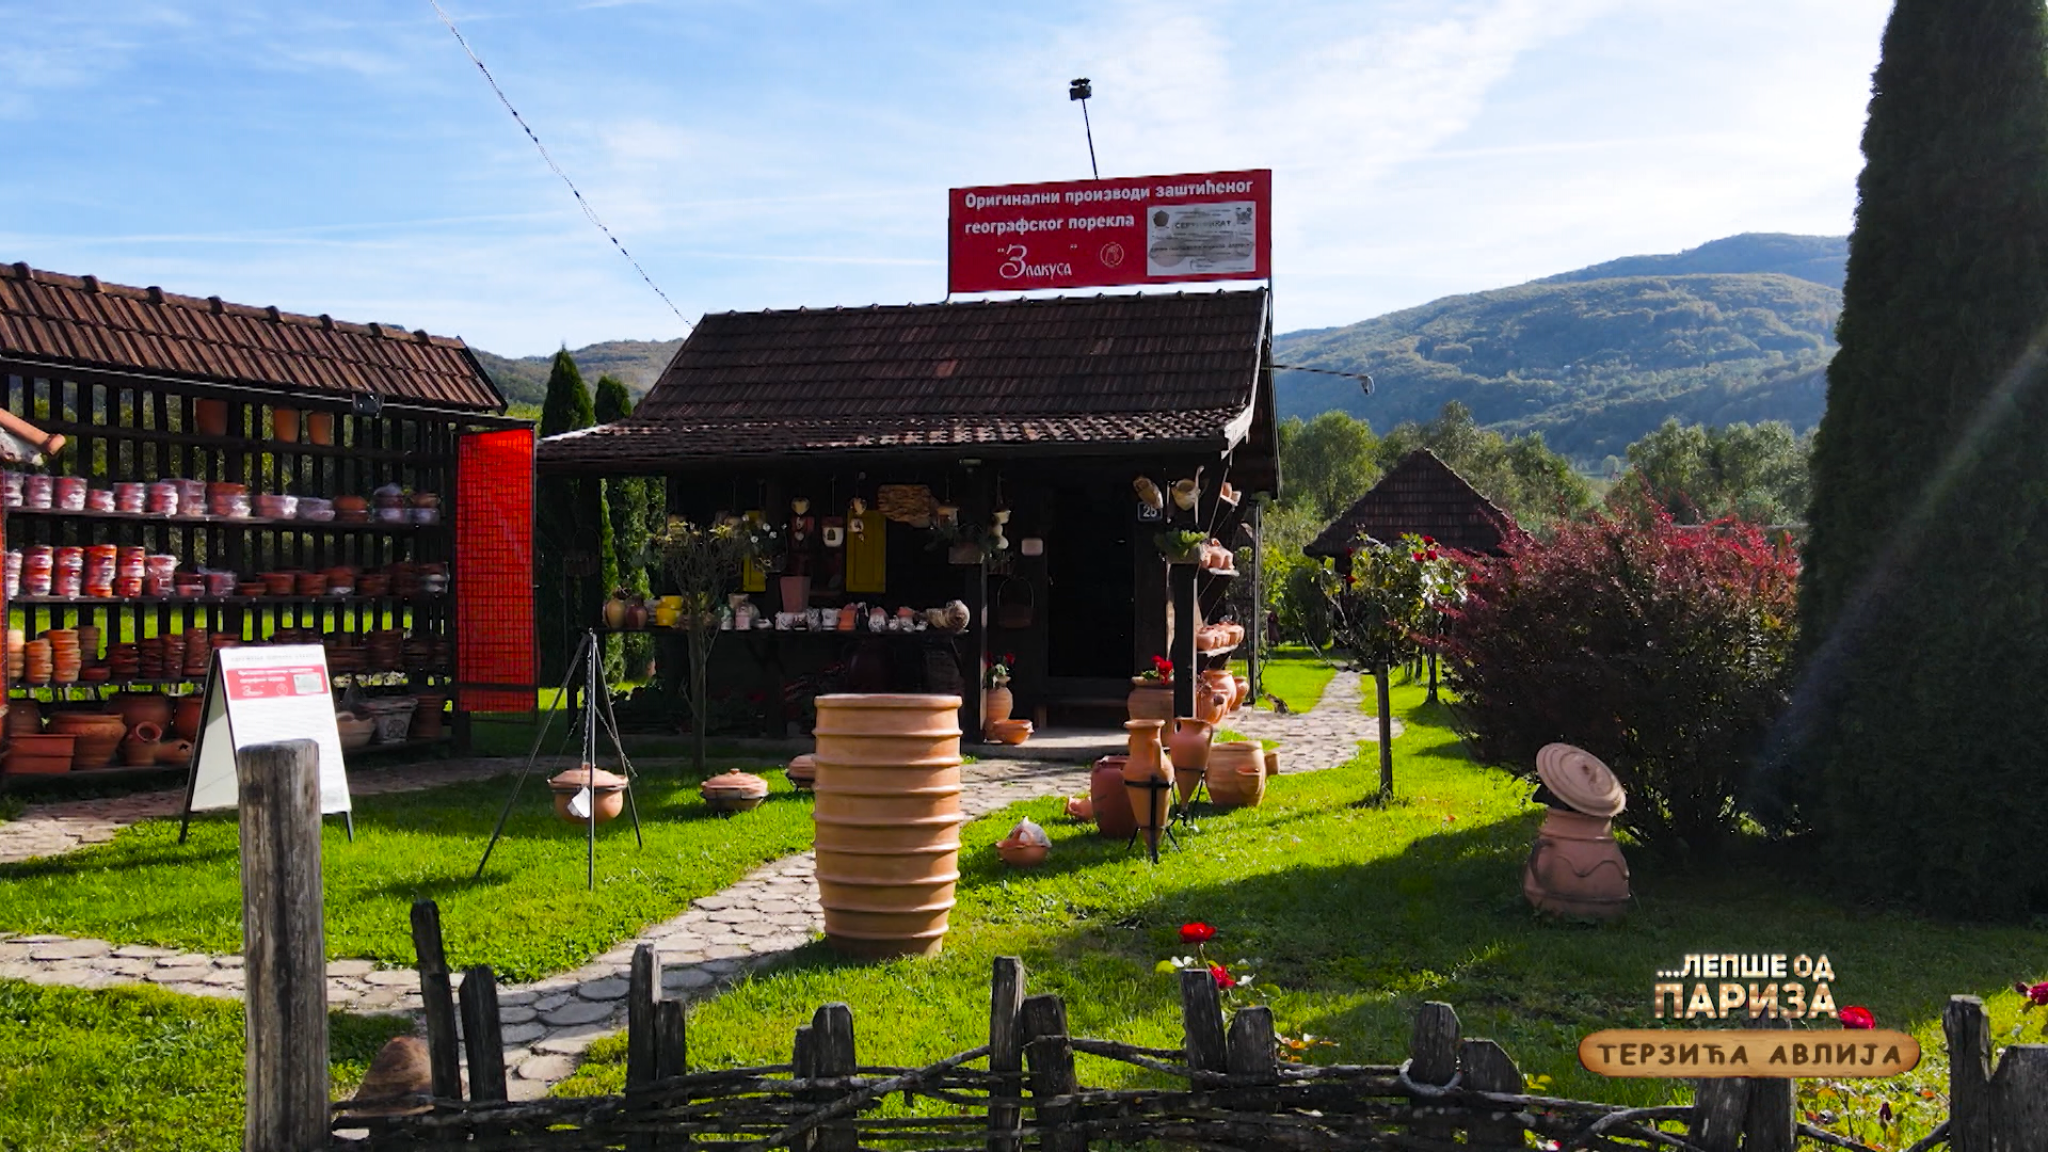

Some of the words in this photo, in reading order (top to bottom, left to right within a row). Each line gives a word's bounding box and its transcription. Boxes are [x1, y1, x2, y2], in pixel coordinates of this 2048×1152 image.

[965, 189, 1060, 210] Оригинални
[1065, 185, 1150, 206] производи
[1155, 180, 1253, 198] заштићеног
[964, 217, 1064, 236] географског
[1068, 214, 1135, 231] порекла
